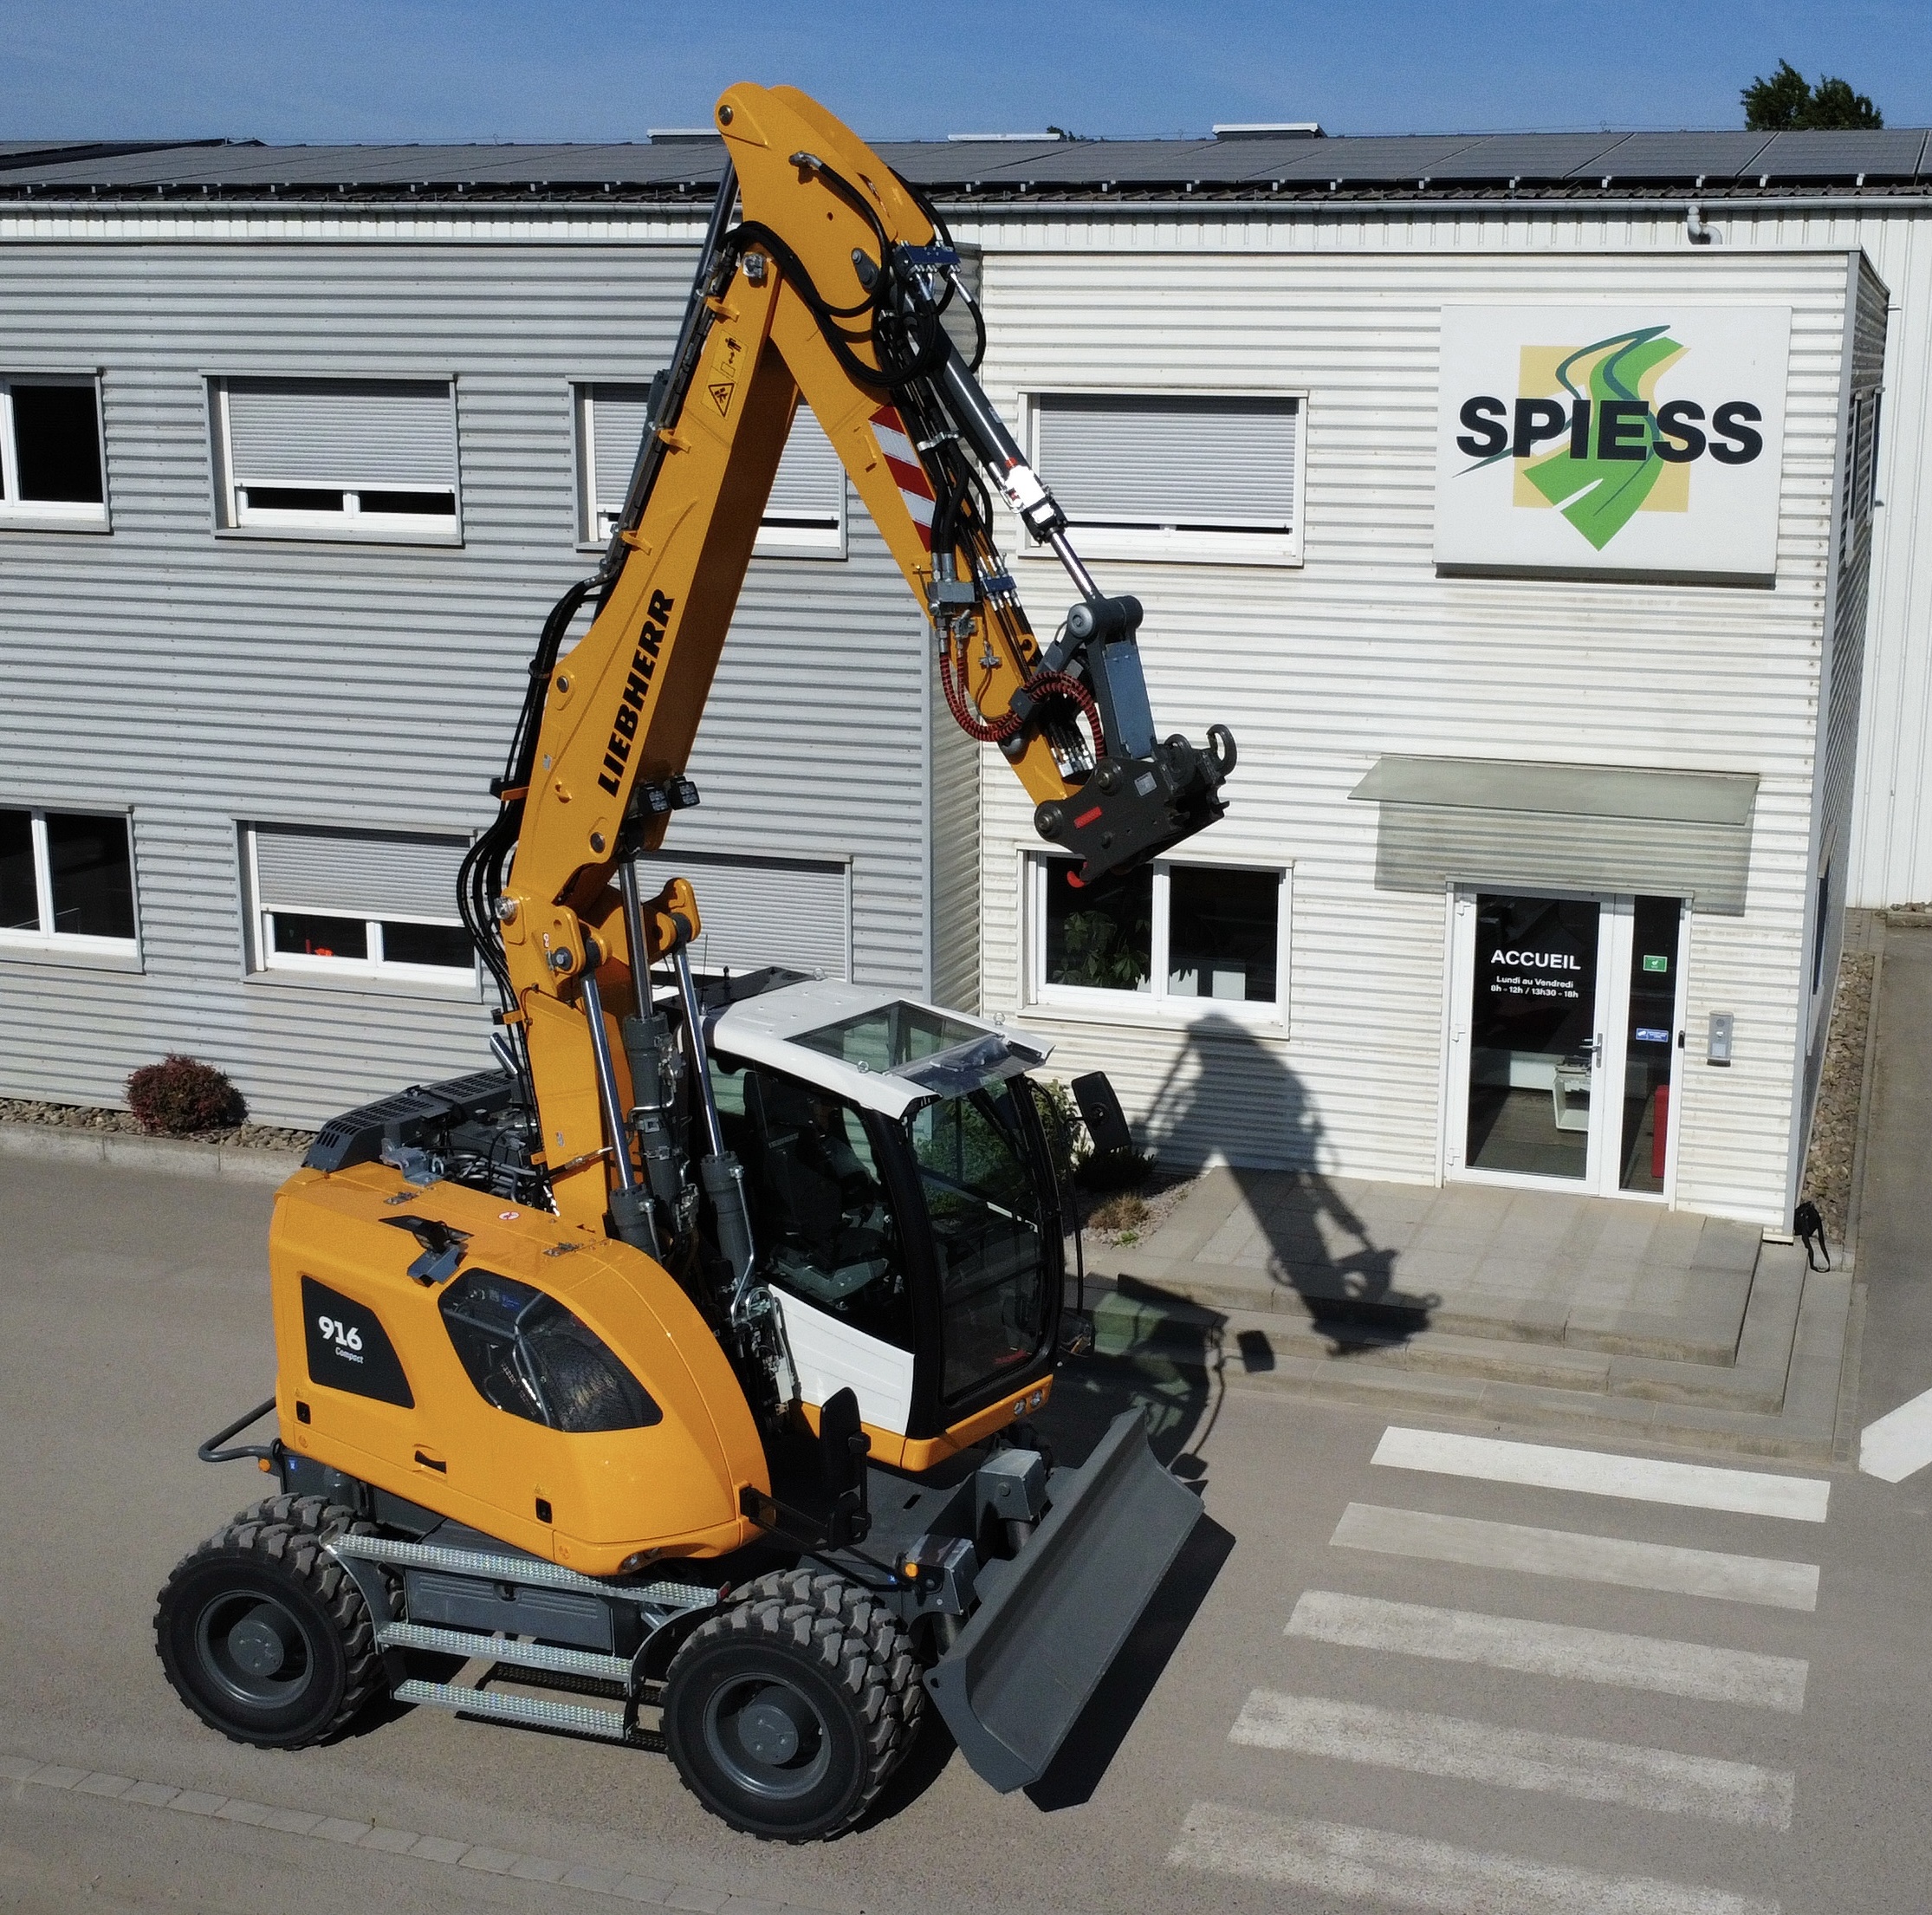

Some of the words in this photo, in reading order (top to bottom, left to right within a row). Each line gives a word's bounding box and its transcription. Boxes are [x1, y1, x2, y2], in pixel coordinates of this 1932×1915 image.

[1456, 396, 1763, 465] SPIESS
[597, 588, 675, 798] LIEBHERR
[1490, 949, 1581, 970] ACCUEIL
[1496, 976, 1520, 984] Lundi
[1534, 978, 1574, 989] Vendredi
[1532, 988, 1557, 996] 13h30
[318, 1315, 363, 1351] 916
[334, 1346, 364, 1364] Compact
